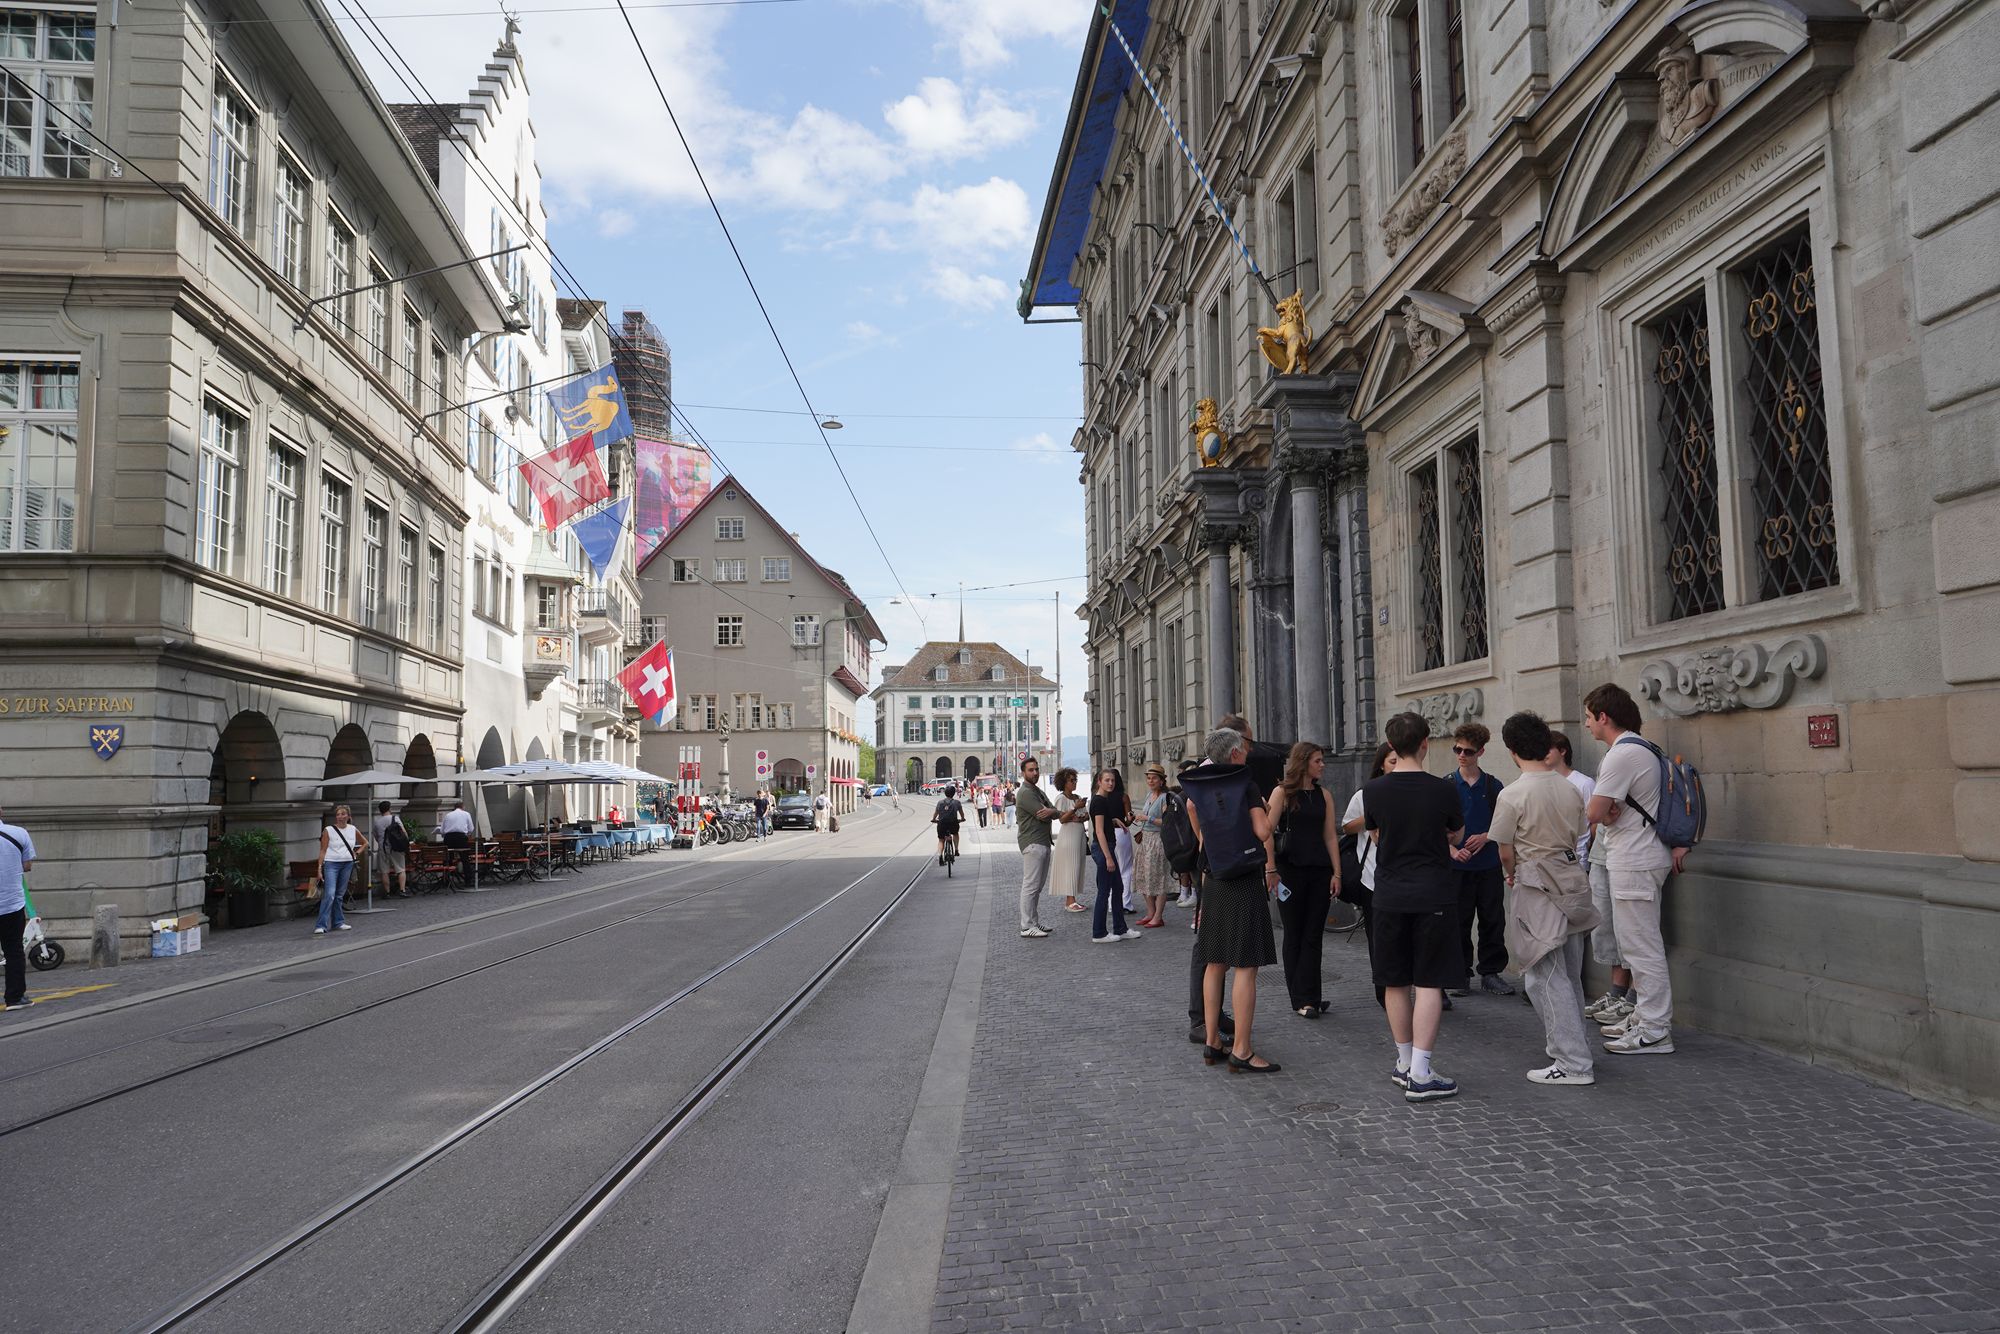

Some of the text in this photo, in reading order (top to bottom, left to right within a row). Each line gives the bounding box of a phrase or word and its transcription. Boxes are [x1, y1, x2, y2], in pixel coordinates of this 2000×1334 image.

[1735, 168, 1747, 188] IN
[14, 697, 50, 713] ZUR
[55, 696, 135, 713] SAFFRAN
